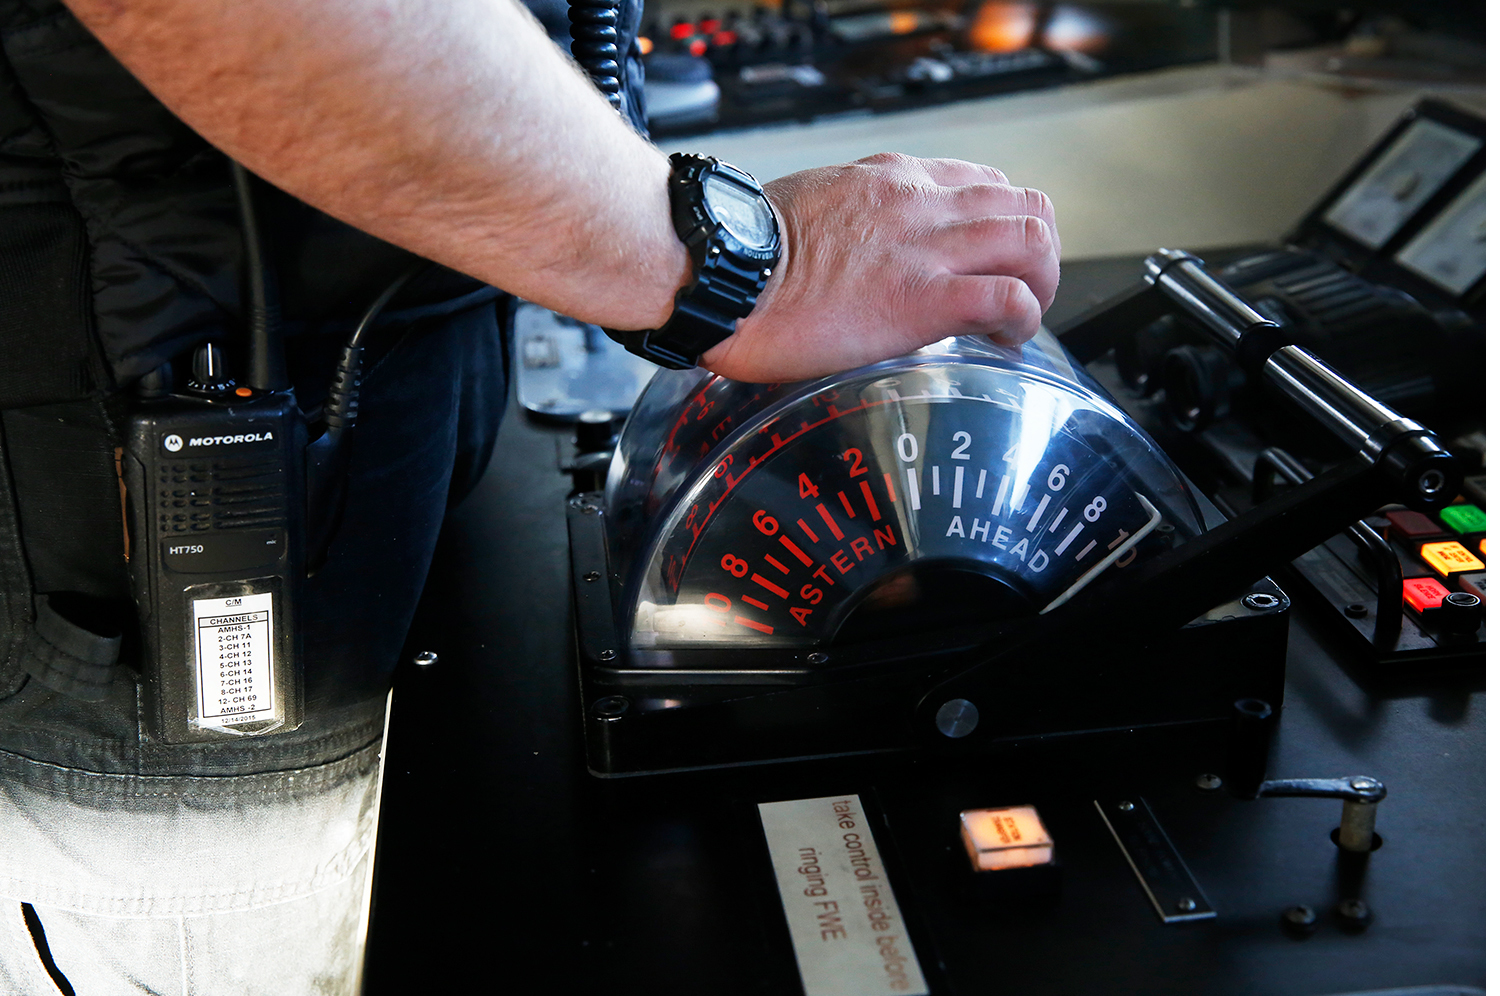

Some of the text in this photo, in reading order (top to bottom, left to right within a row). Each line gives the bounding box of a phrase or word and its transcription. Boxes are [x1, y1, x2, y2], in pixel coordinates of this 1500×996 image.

[743, 248, 774, 260] VIBRATION
[189, 431, 274, 447] MOTOROLA
[720, 553, 749, 578] 8
[752, 509, 780, 537] 6
[798, 472, 820, 500] 4
[843, 447, 870, 479] 2
[896, 433, 919, 462] 0
[950, 430, 972, 461] 2
[1047, 463, 1071, 492] 6
[1083, 495, 1108, 523] 8
[945, 515, 1051, 573] AHEAD
[169, 544, 204, 555] HT750
[788, 524, 897, 627] ASTERN
[225, 598, 242, 606] C/M
[209, 613, 259, 625] CHANNELS
[218, 624, 251, 633] AMHS-1
[218, 634, 239, 643] 2-CH
[219, 643, 240, 651] 3-CH
[219, 652, 240, 660] 4-CH
[220, 661, 240, 669] 5-CH
[220, 670, 241, 678] 6-CH
[220, 705, 246, 714] AMHS
[221, 715, 256, 724] 12/14/2015
[797, 846, 847, 942] ringing FWE
[832, 799, 911, 992] take control inside before
